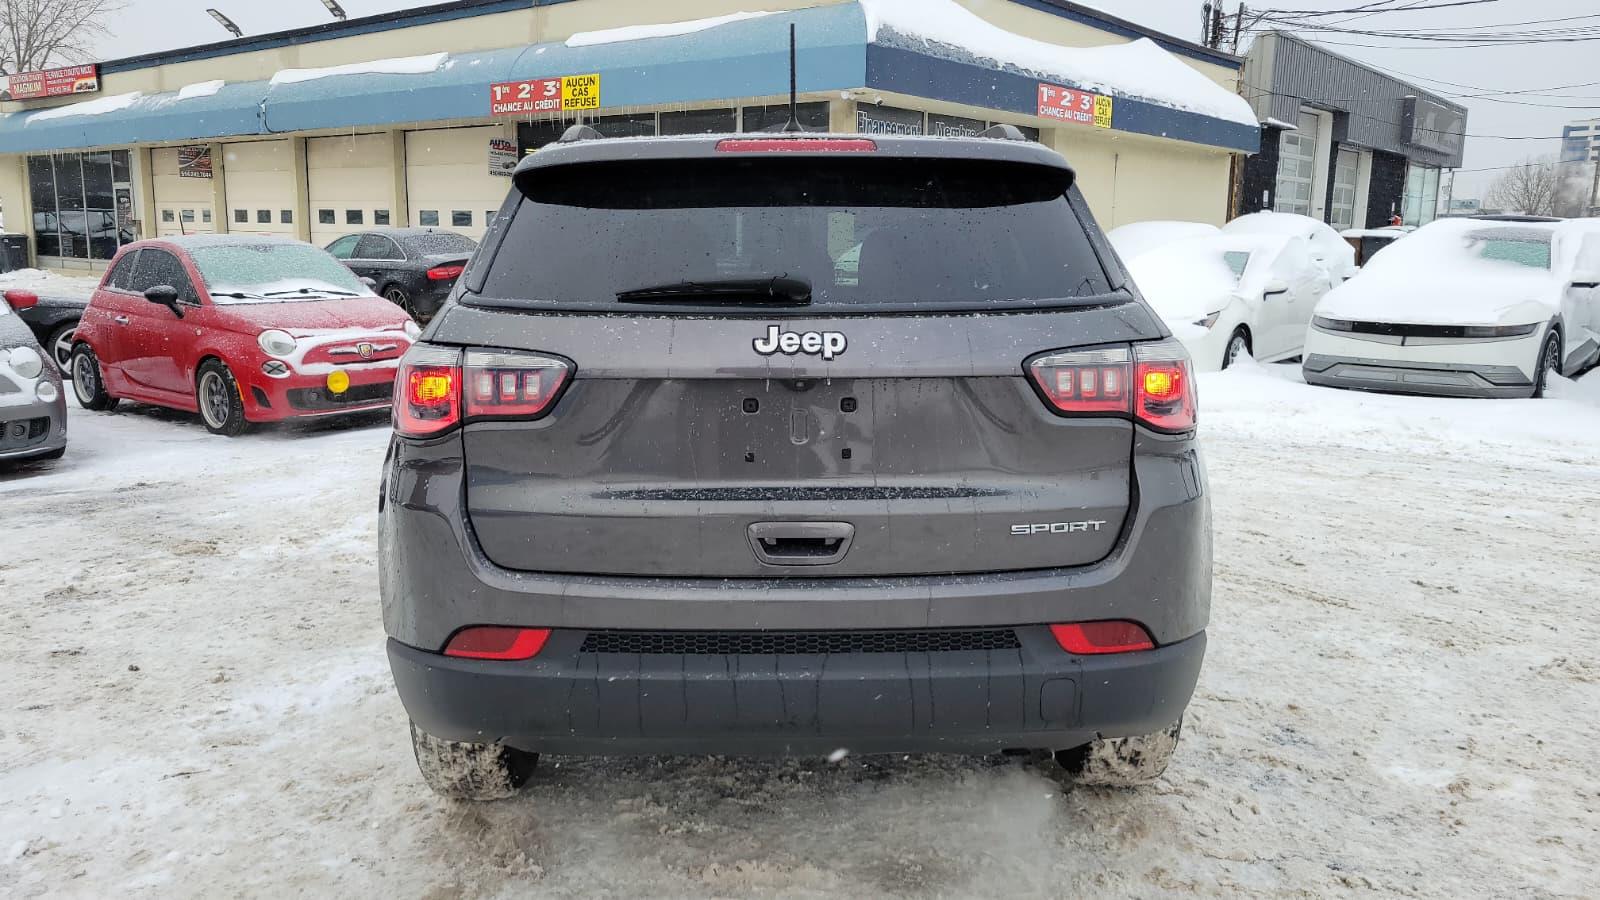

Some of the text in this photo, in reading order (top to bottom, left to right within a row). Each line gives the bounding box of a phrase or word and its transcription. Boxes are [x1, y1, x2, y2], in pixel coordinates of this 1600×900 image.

[13, 82, 42, 94] MAGNUM
[565, 77, 596, 88] AUCUN
[571, 87, 589, 97] CAS
[493, 97, 561, 113] CHANCE AU CRÉDIT
[1040, 104, 1064, 119] CHANCE
[1064, 109, 1074, 119] AU
[489, 139, 511, 147] AUTO
[752, 324, 848, 361] Jeep
[1010, 520, 1107, 535] SPORT
